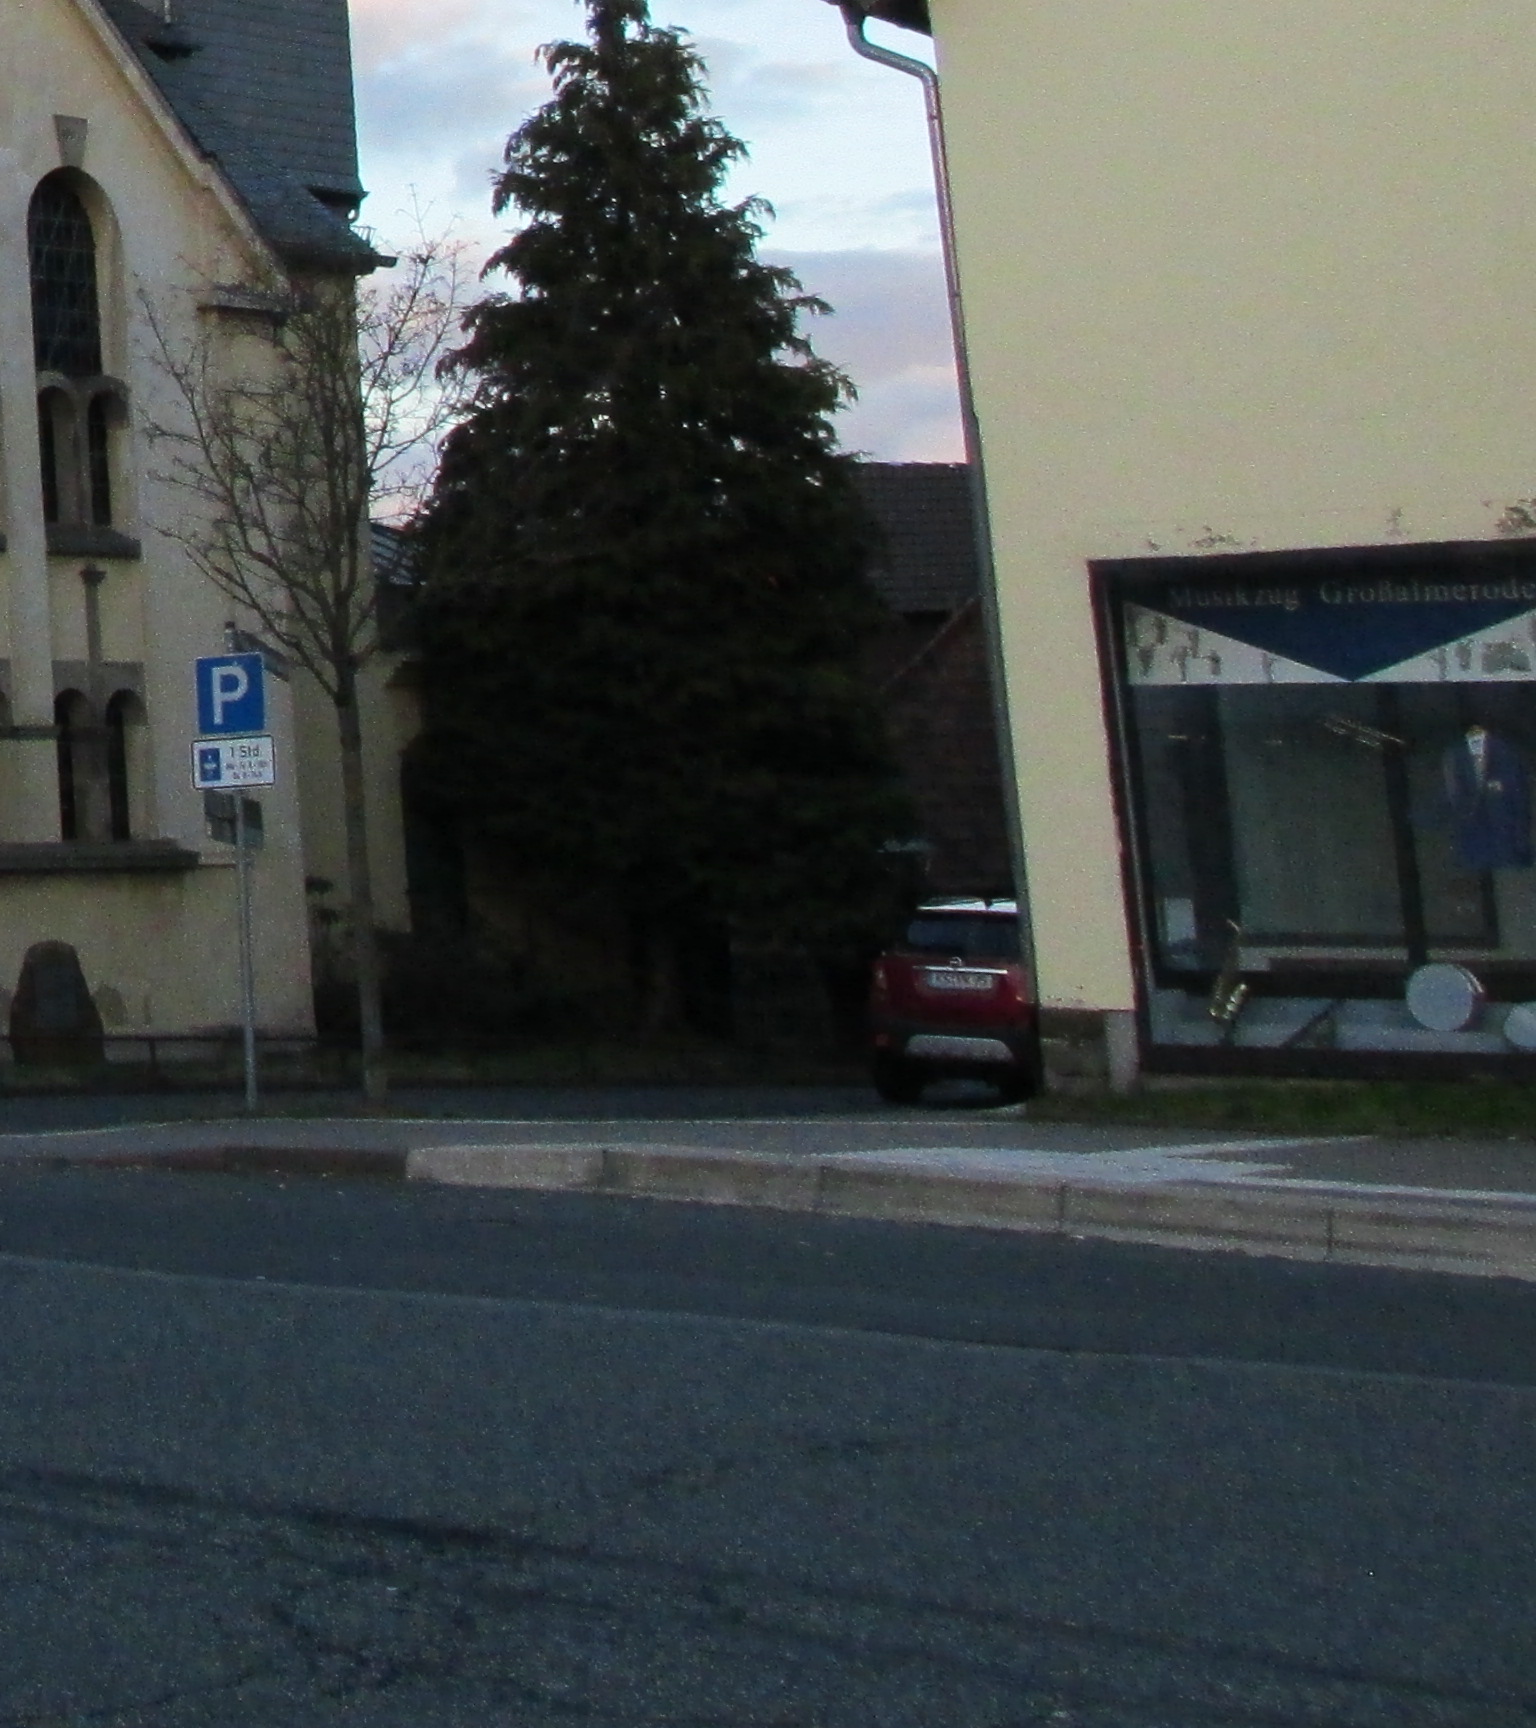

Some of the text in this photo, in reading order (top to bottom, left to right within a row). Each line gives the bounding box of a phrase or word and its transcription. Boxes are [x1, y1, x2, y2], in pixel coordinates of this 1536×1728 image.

[1168, 585, 1300, 611] Musikzug
[211, 665, 248, 725] P
[229, 746, 235, 758] 1
